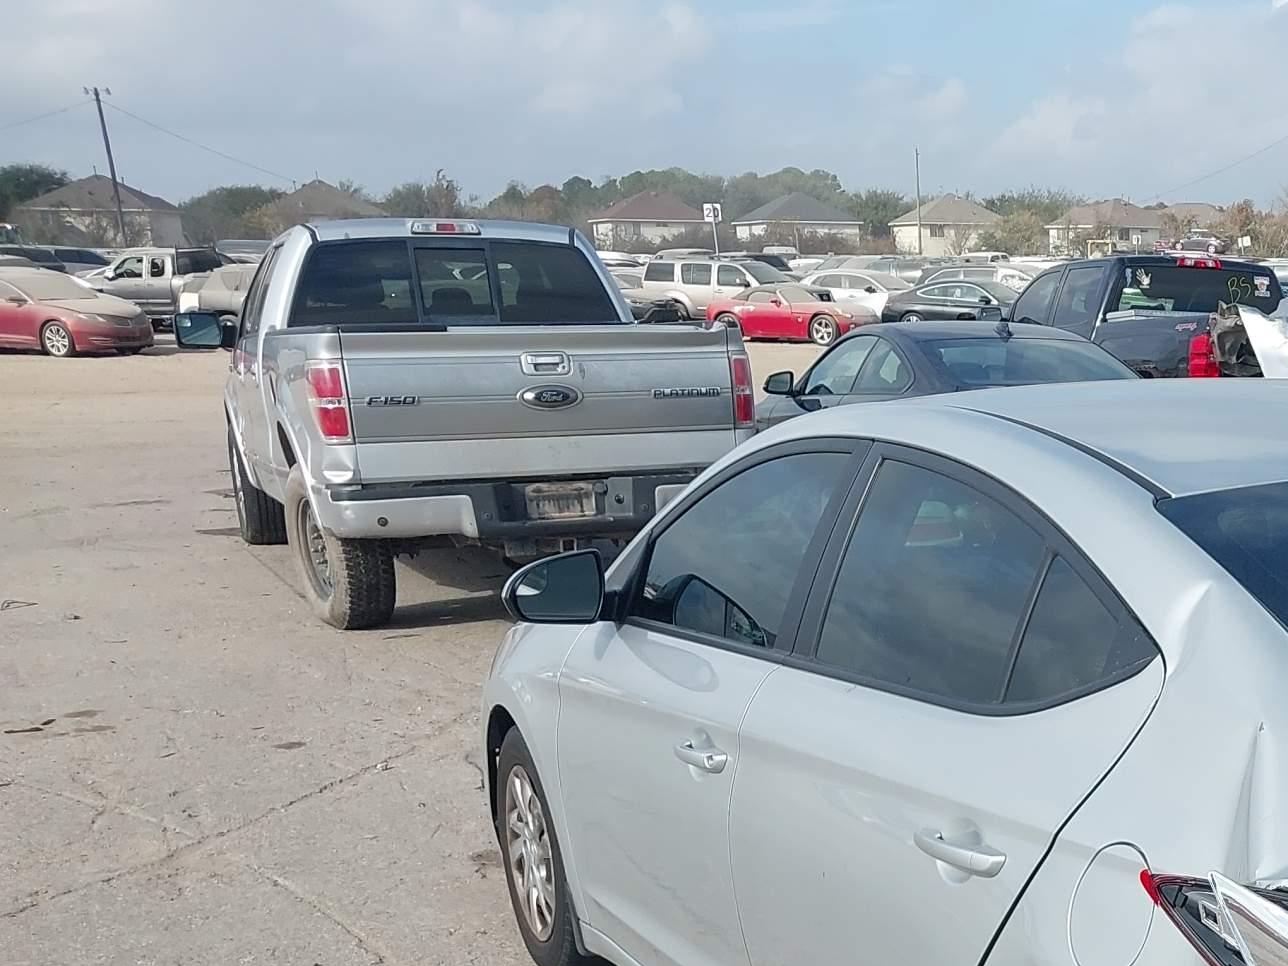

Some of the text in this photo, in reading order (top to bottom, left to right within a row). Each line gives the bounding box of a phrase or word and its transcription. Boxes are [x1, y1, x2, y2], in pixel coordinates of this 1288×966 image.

[705, 207, 720, 218] 20
[540, 391, 564, 402] Ford
[653, 387, 720, 399] PLATINUM
